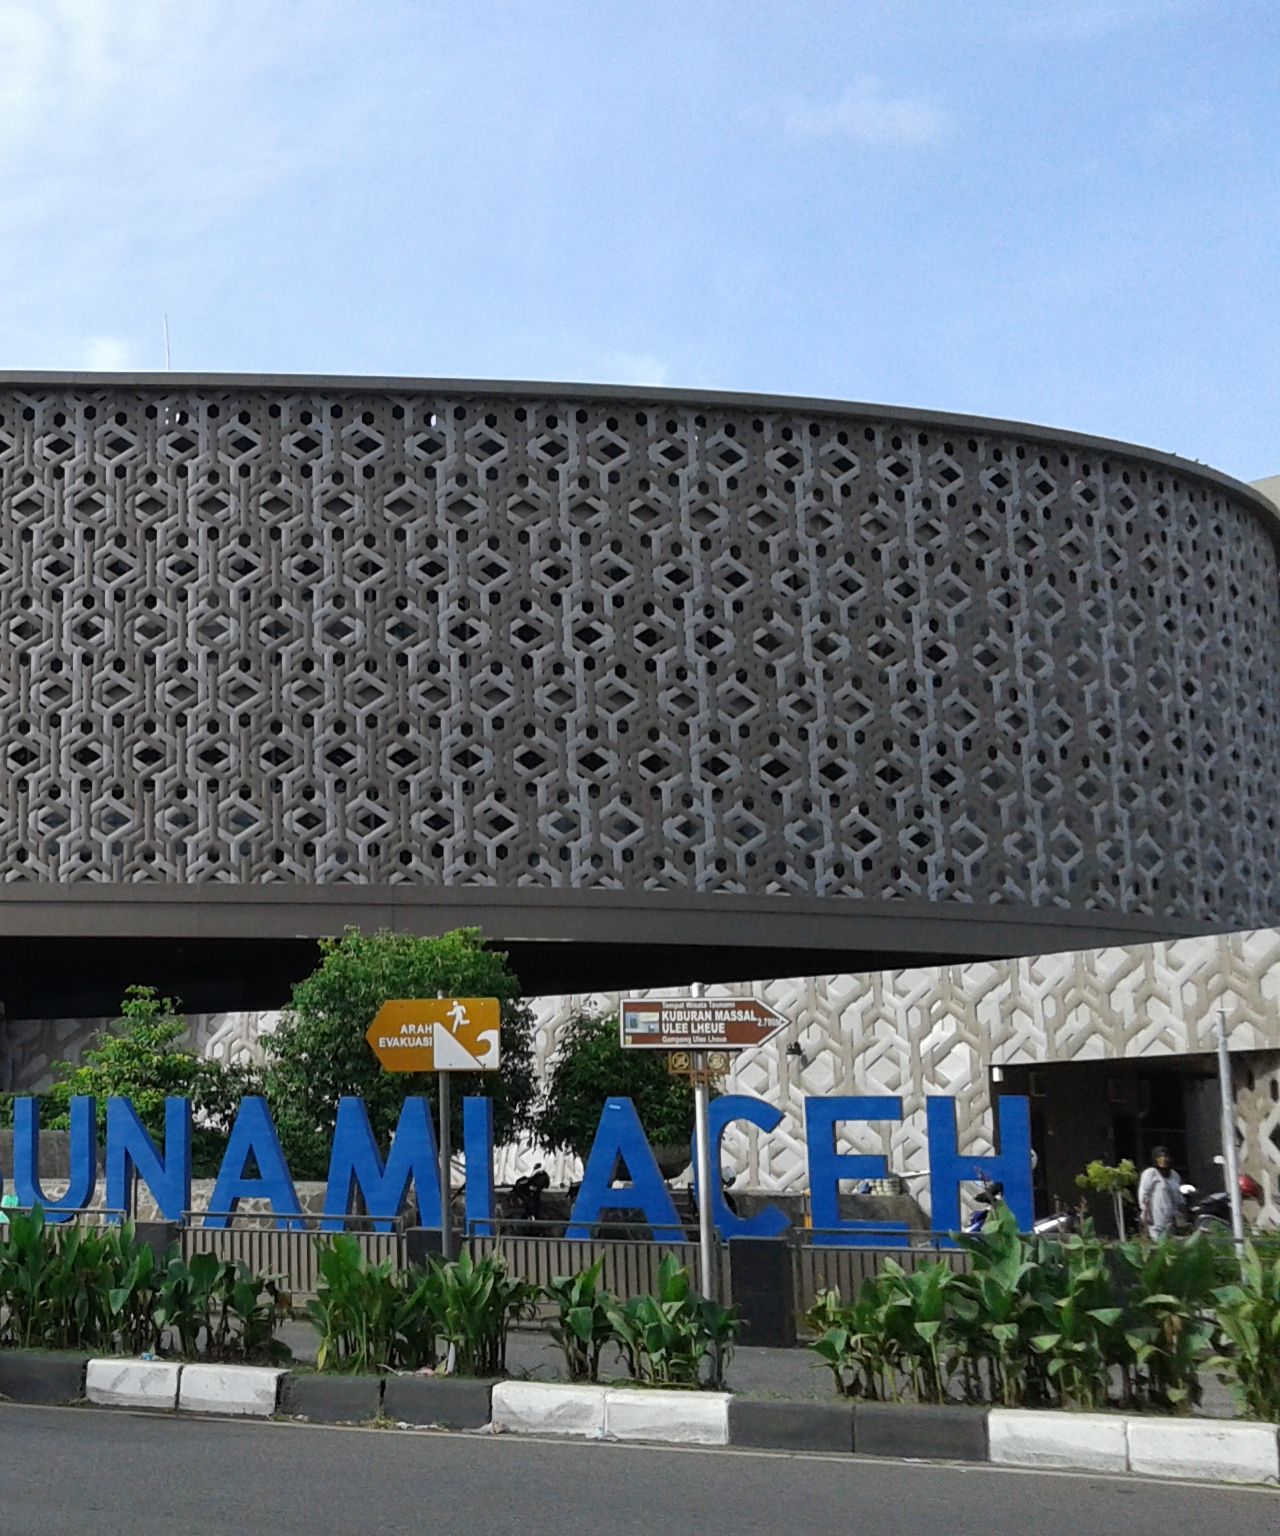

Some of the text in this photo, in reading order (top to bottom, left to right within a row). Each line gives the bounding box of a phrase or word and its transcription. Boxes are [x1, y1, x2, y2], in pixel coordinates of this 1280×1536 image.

[661, 1010, 757, 1022] KUBURAN MASSAL
[400, 1023, 433, 1035] ARAH
[661, 1022, 726, 1034] ULEE LHEUE
[378, 1036, 433, 1048] EVAKUASI
[564, 1094, 1034, 1248] ACEH
